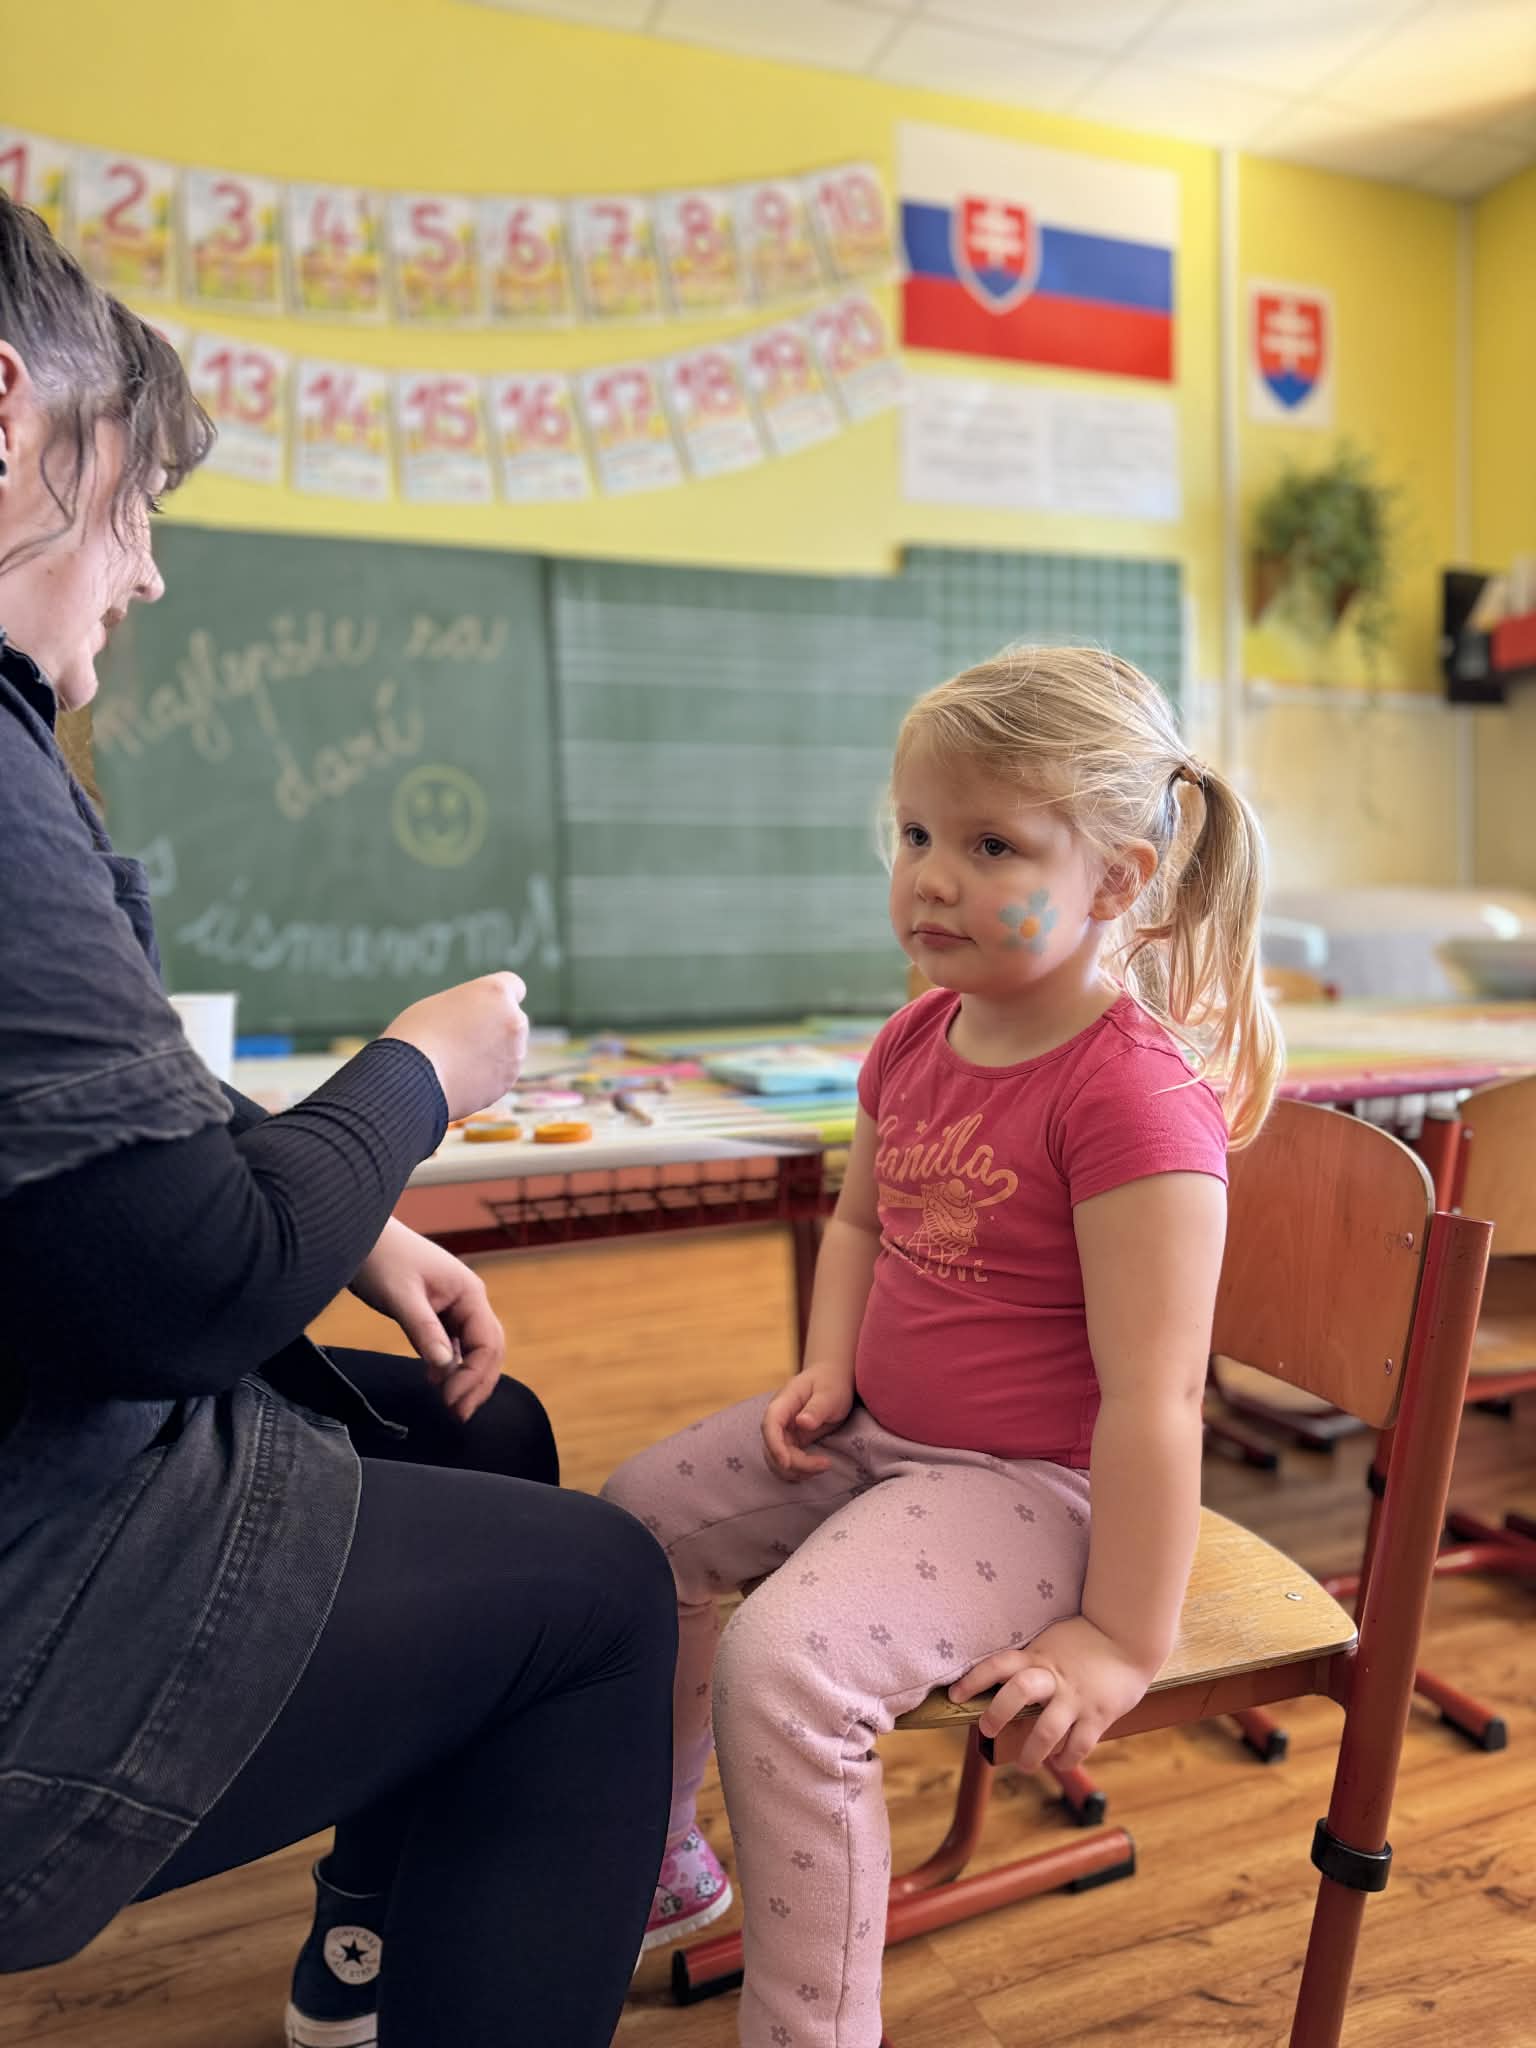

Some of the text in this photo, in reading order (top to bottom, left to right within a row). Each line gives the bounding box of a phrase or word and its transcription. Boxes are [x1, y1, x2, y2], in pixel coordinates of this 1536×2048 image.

[0, 142, 885, 277] 1 2 3 4 5 6 7 8 9 10
[201, 298, 886, 449] 13 14 15 16 17 18 19 20
